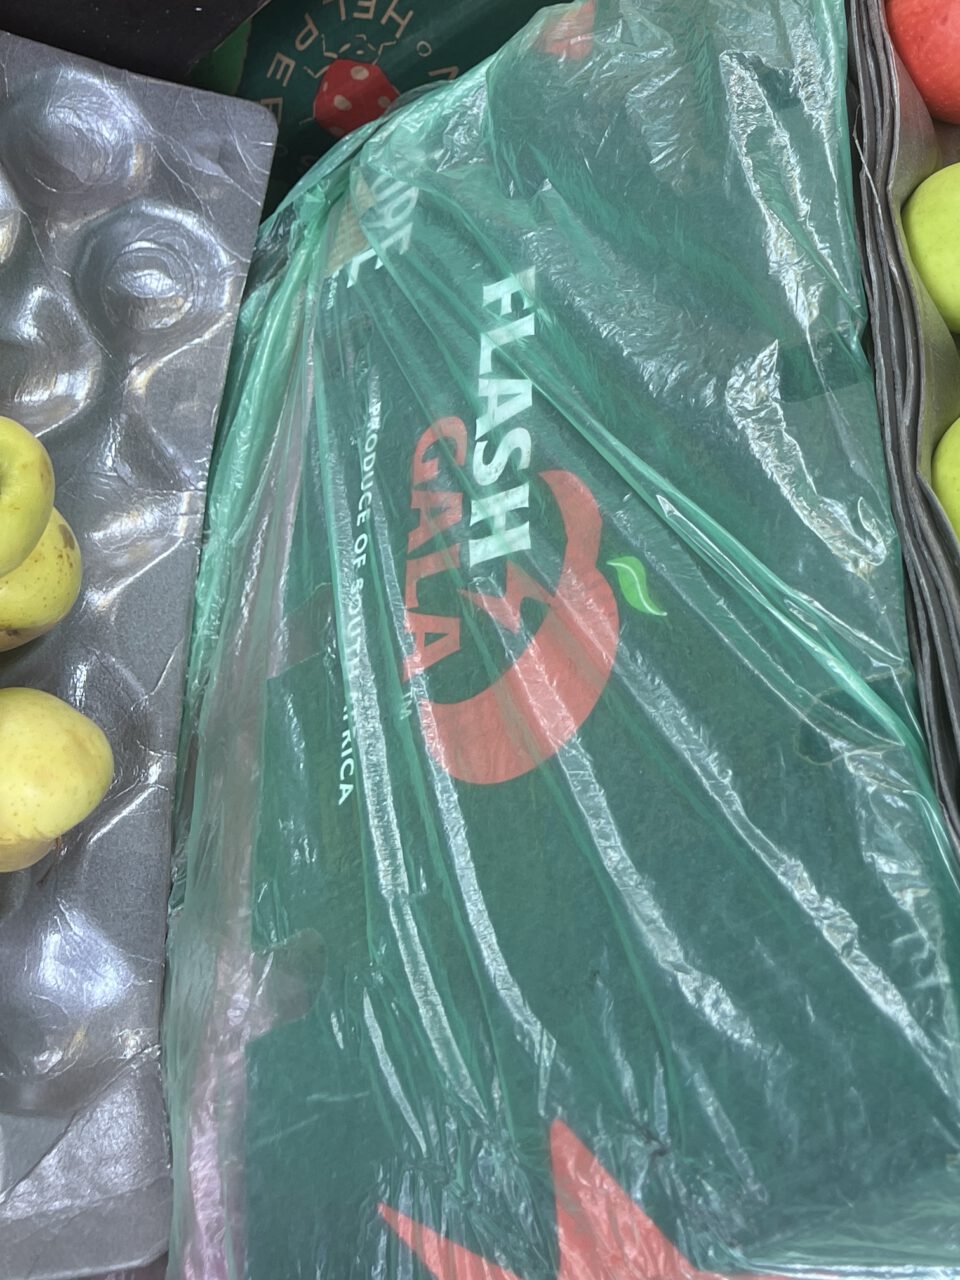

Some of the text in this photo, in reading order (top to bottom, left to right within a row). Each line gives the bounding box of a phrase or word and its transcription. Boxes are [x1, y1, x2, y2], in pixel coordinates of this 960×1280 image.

[356, 401, 381, 527] PRODUCE
[469, 266, 536, 567] FLASH
[352, 532, 368, 569] OF
[403, 416, 468, 682] GALA
[338, 694, 357, 806] RICA
